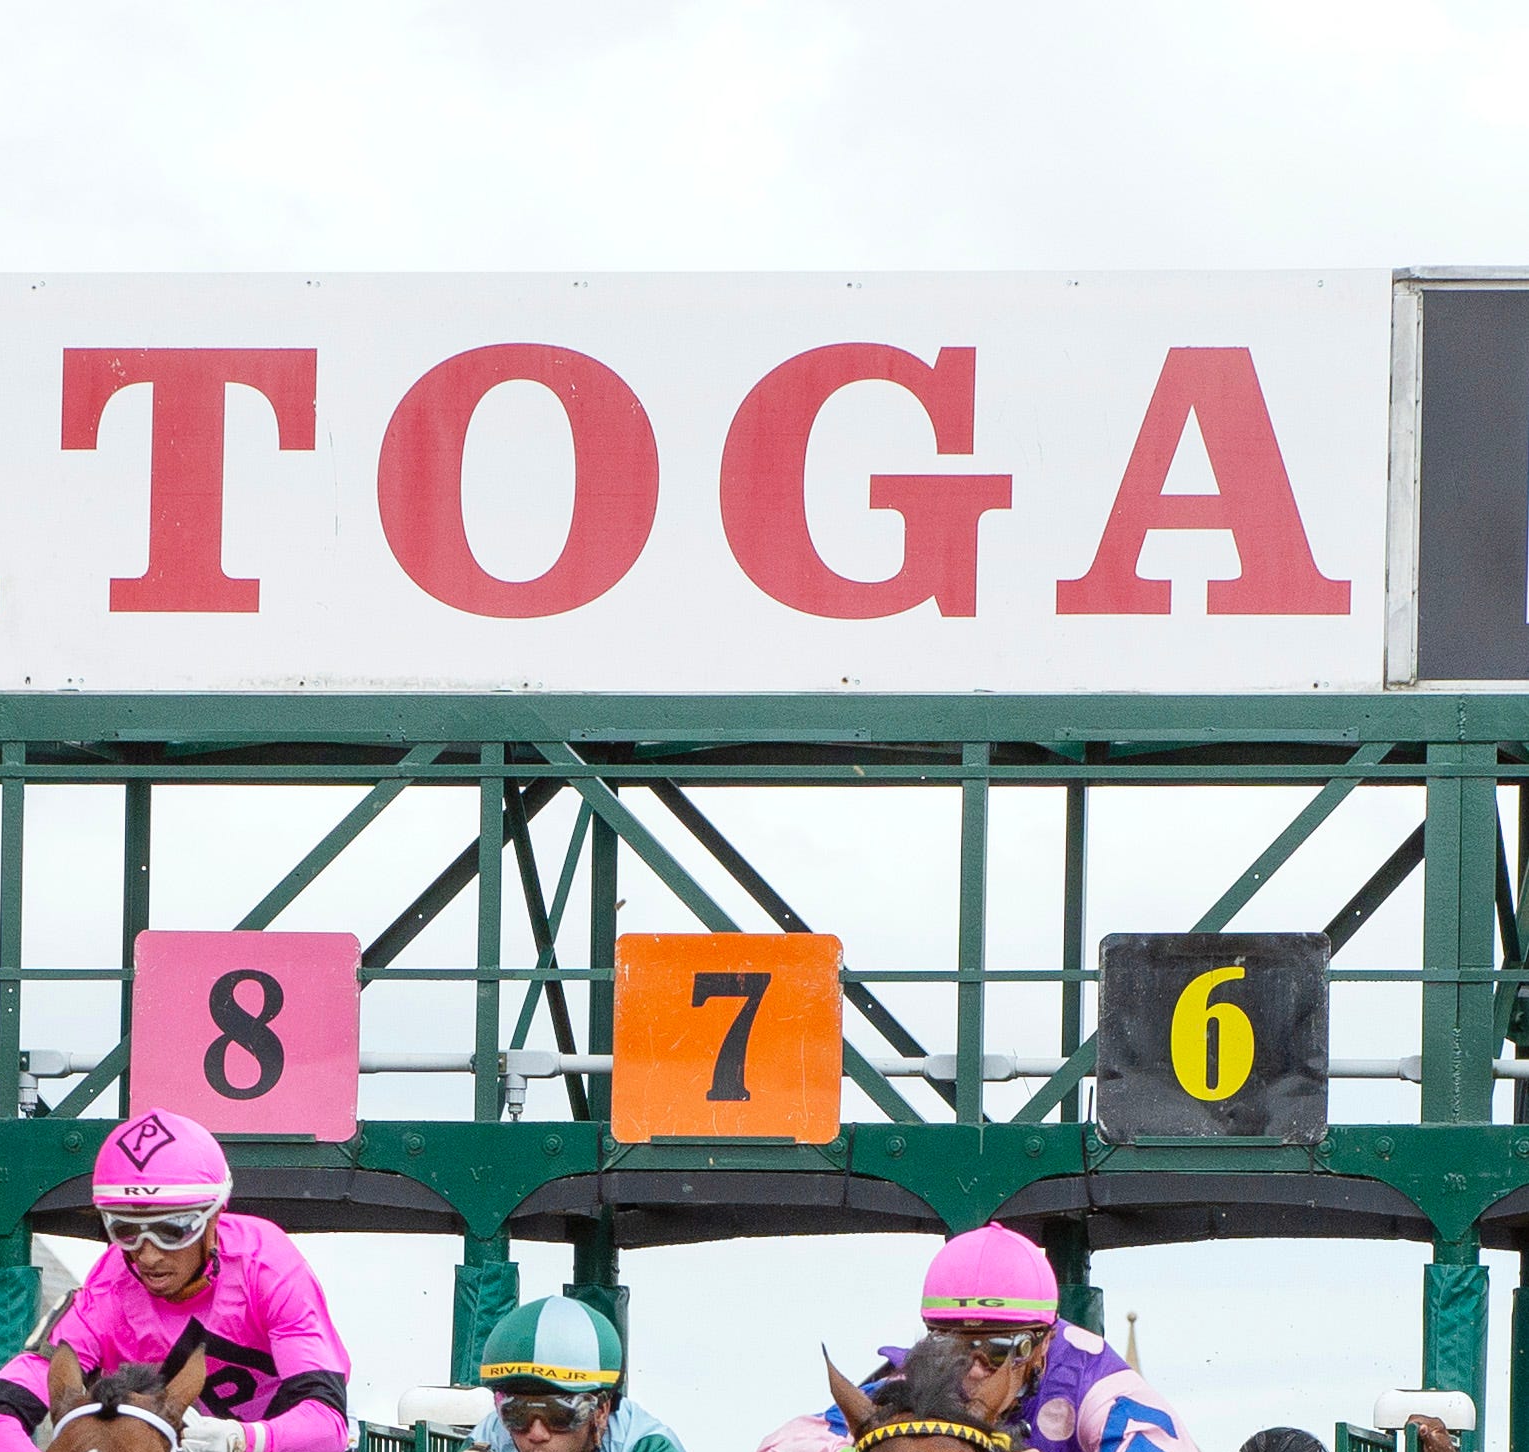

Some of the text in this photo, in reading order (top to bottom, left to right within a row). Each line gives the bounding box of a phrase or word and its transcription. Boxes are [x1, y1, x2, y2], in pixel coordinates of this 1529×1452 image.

[204, 969, 284, 1099] 8
[692, 973, 771, 1101] 7
[1170, 966, 1255, 1102] 6
[133, 1123, 158, 1152] P
[124, 1186, 161, 1196] RV
[951, 1297, 1005, 1307] TG
[489, 1365, 588, 1381] RIVERA JR
